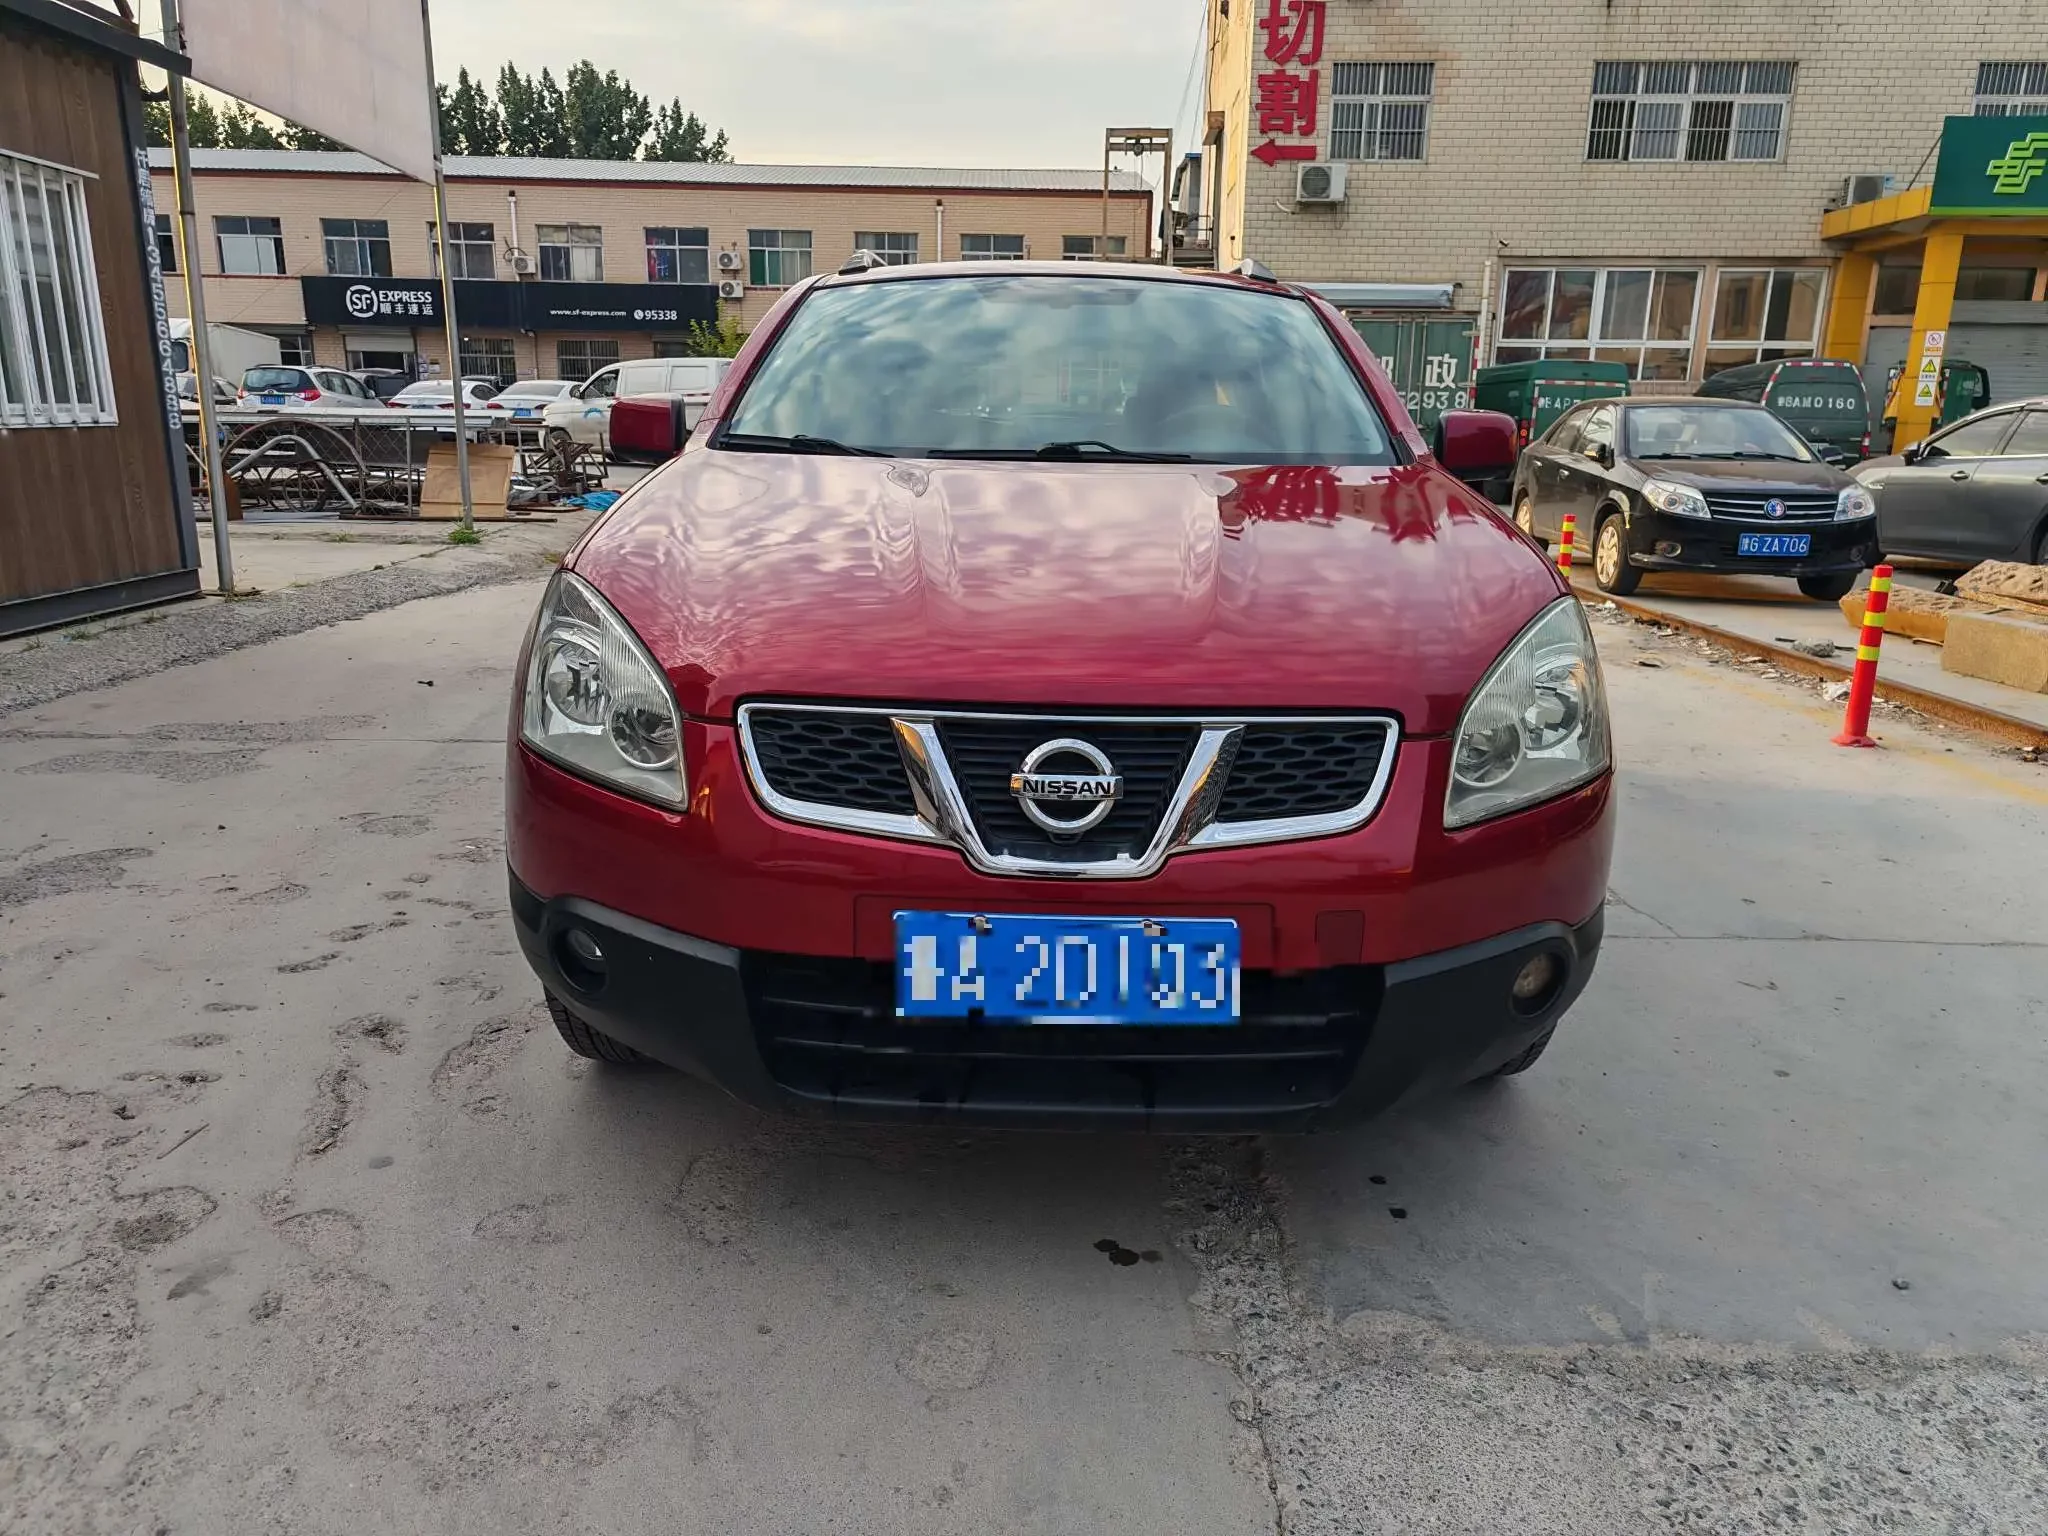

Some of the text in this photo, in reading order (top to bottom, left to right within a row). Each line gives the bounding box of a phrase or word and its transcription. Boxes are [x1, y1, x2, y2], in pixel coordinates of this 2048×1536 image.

[1255, 0, 1327, 136] 切割
[379, 290, 433, 303] EXPRESS
[380, 303, 434, 316] 顺丰速运
[549, 308, 627, 317] www.sf-express.com
[644, 309, 678, 321] 95338
[1023, 780, 1111, 796] NISSAN
